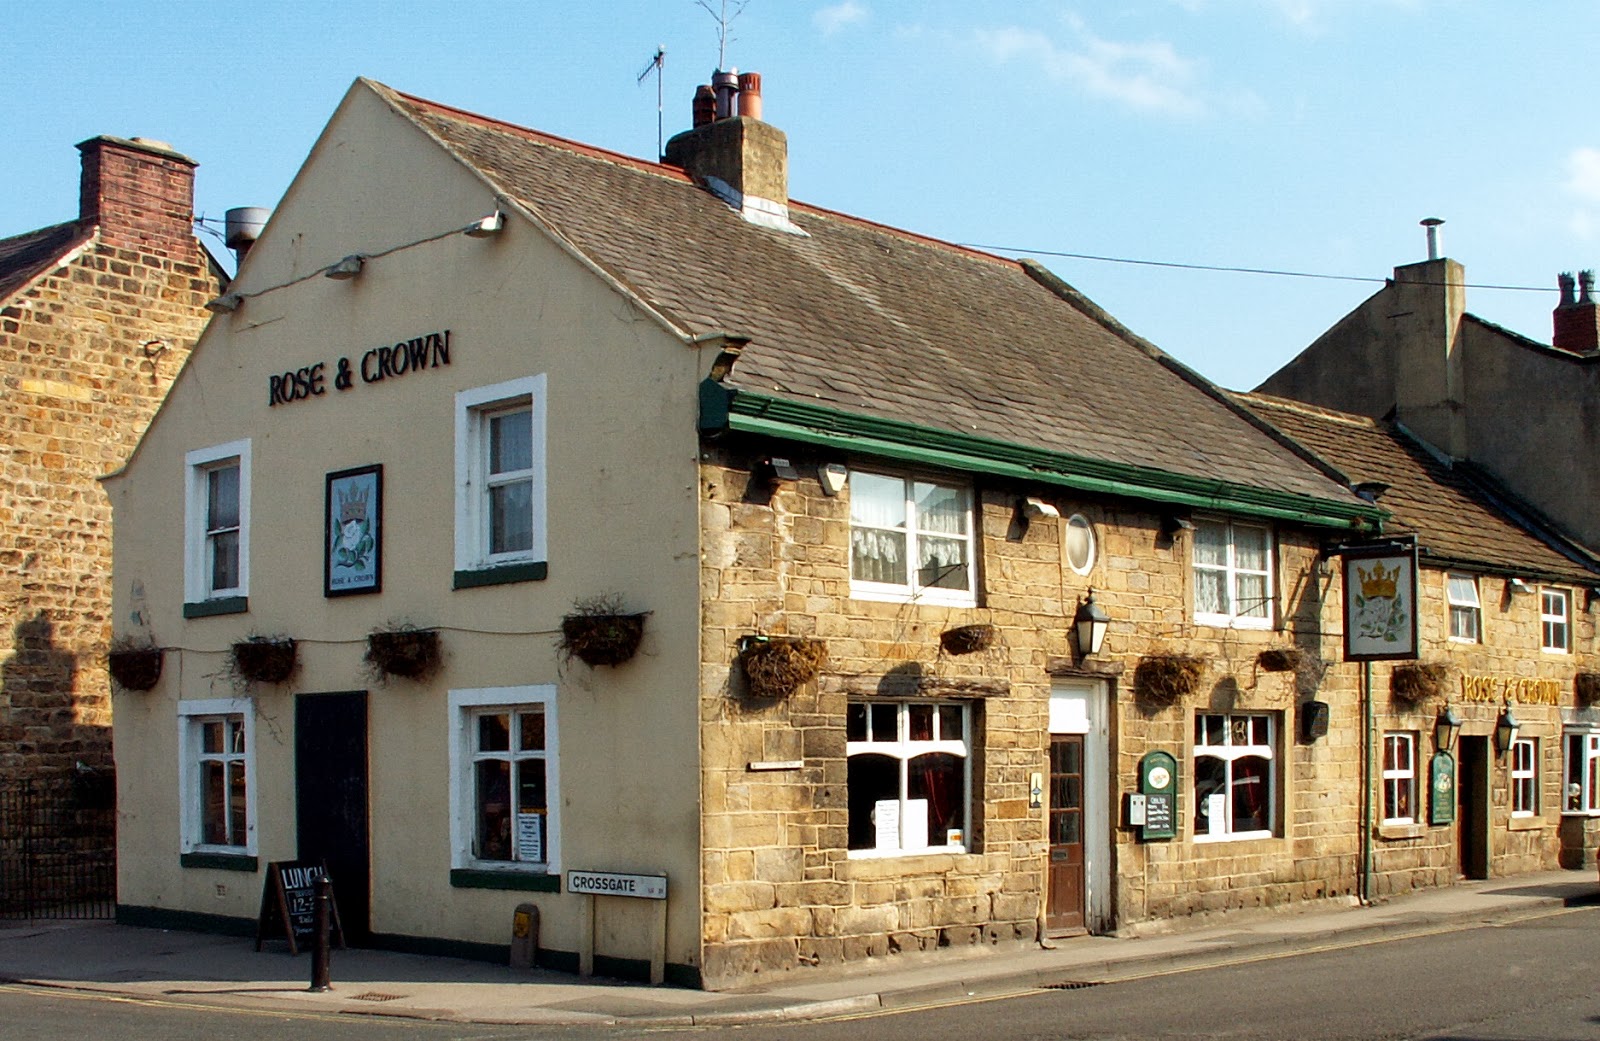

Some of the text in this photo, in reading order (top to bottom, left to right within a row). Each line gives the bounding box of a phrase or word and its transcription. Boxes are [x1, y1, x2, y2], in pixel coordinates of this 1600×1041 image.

[269, 330, 452, 407] ROSE & CROWN
[1462, 674, 1498, 702] ROSE
[1517, 678, 1561, 706] CROWN
[573, 876, 635, 892] CROSSGATE
